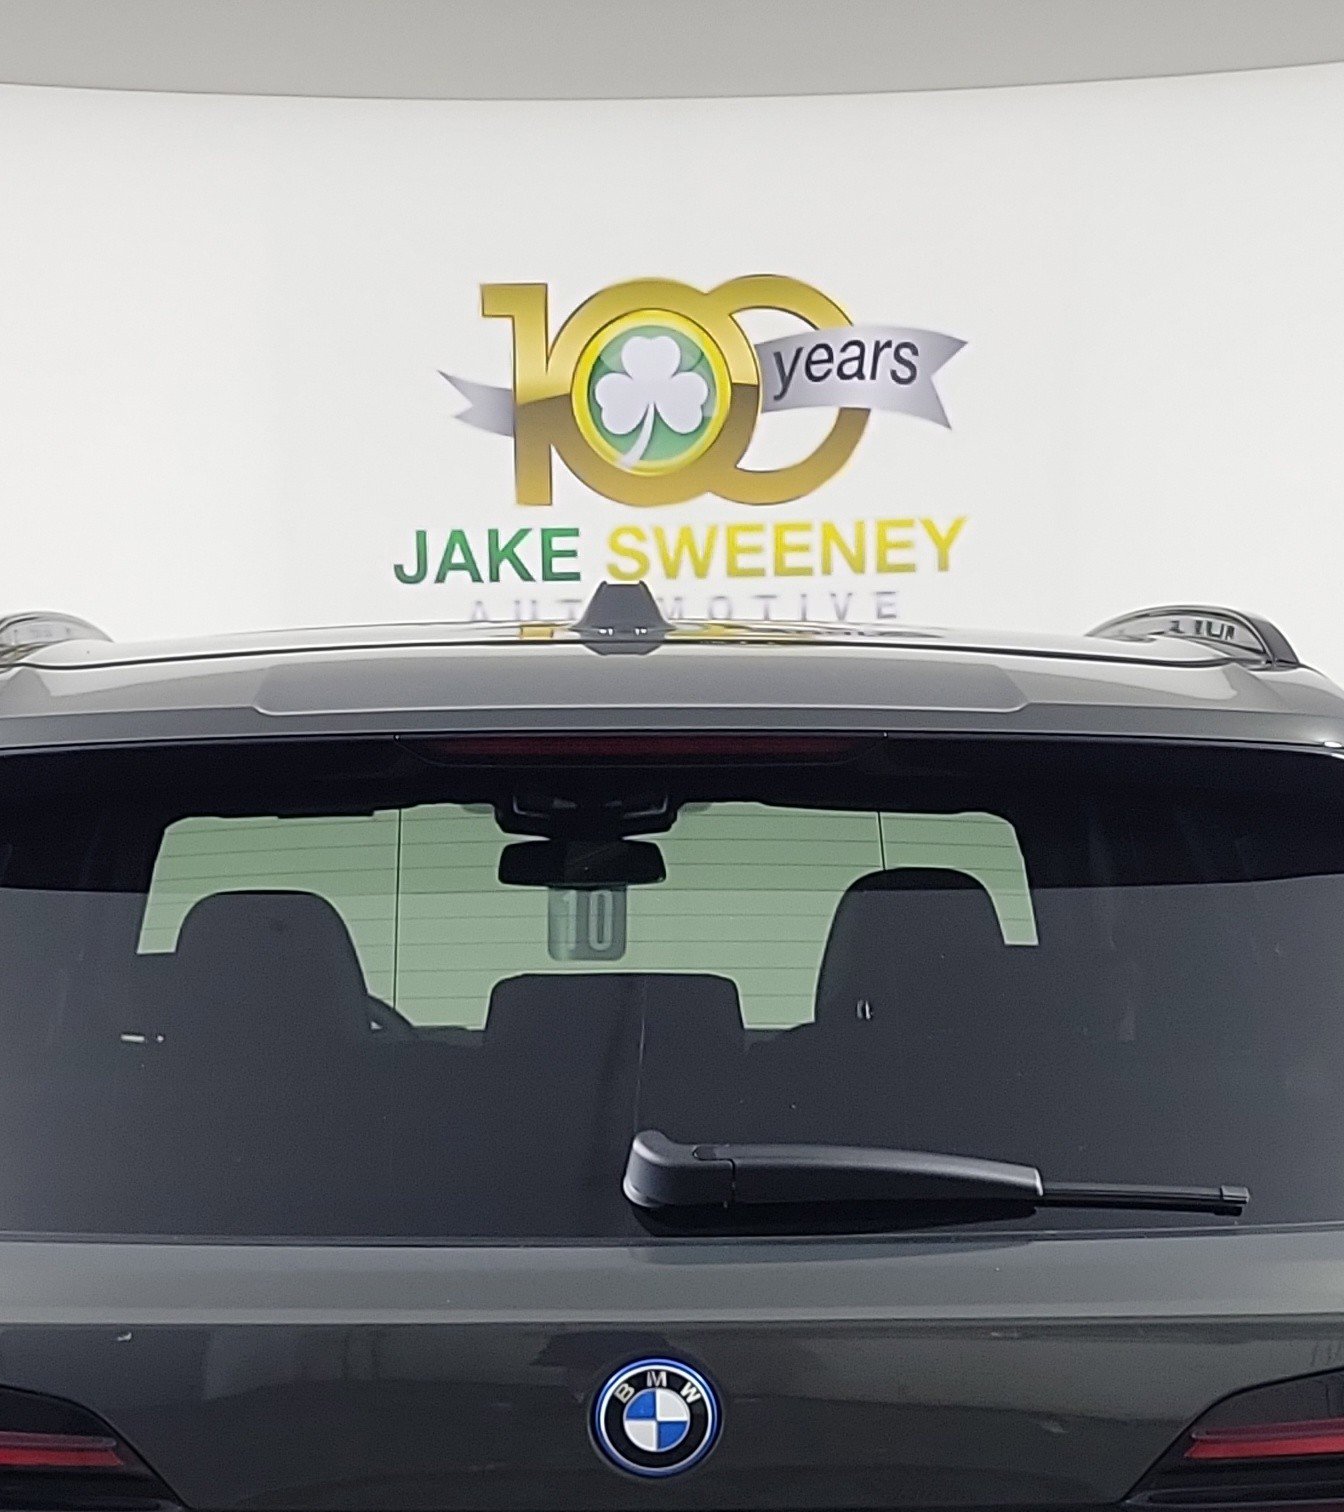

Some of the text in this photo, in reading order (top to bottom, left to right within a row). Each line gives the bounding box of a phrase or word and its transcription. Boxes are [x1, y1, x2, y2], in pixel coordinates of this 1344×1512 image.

[479, 274, 920, 507] 100 years
[393, 515, 968, 585] JAKE SWEENEY
[469, 591, 899, 622] AUTMOTIVE
[613, 1370, 702, 1404] BMW
